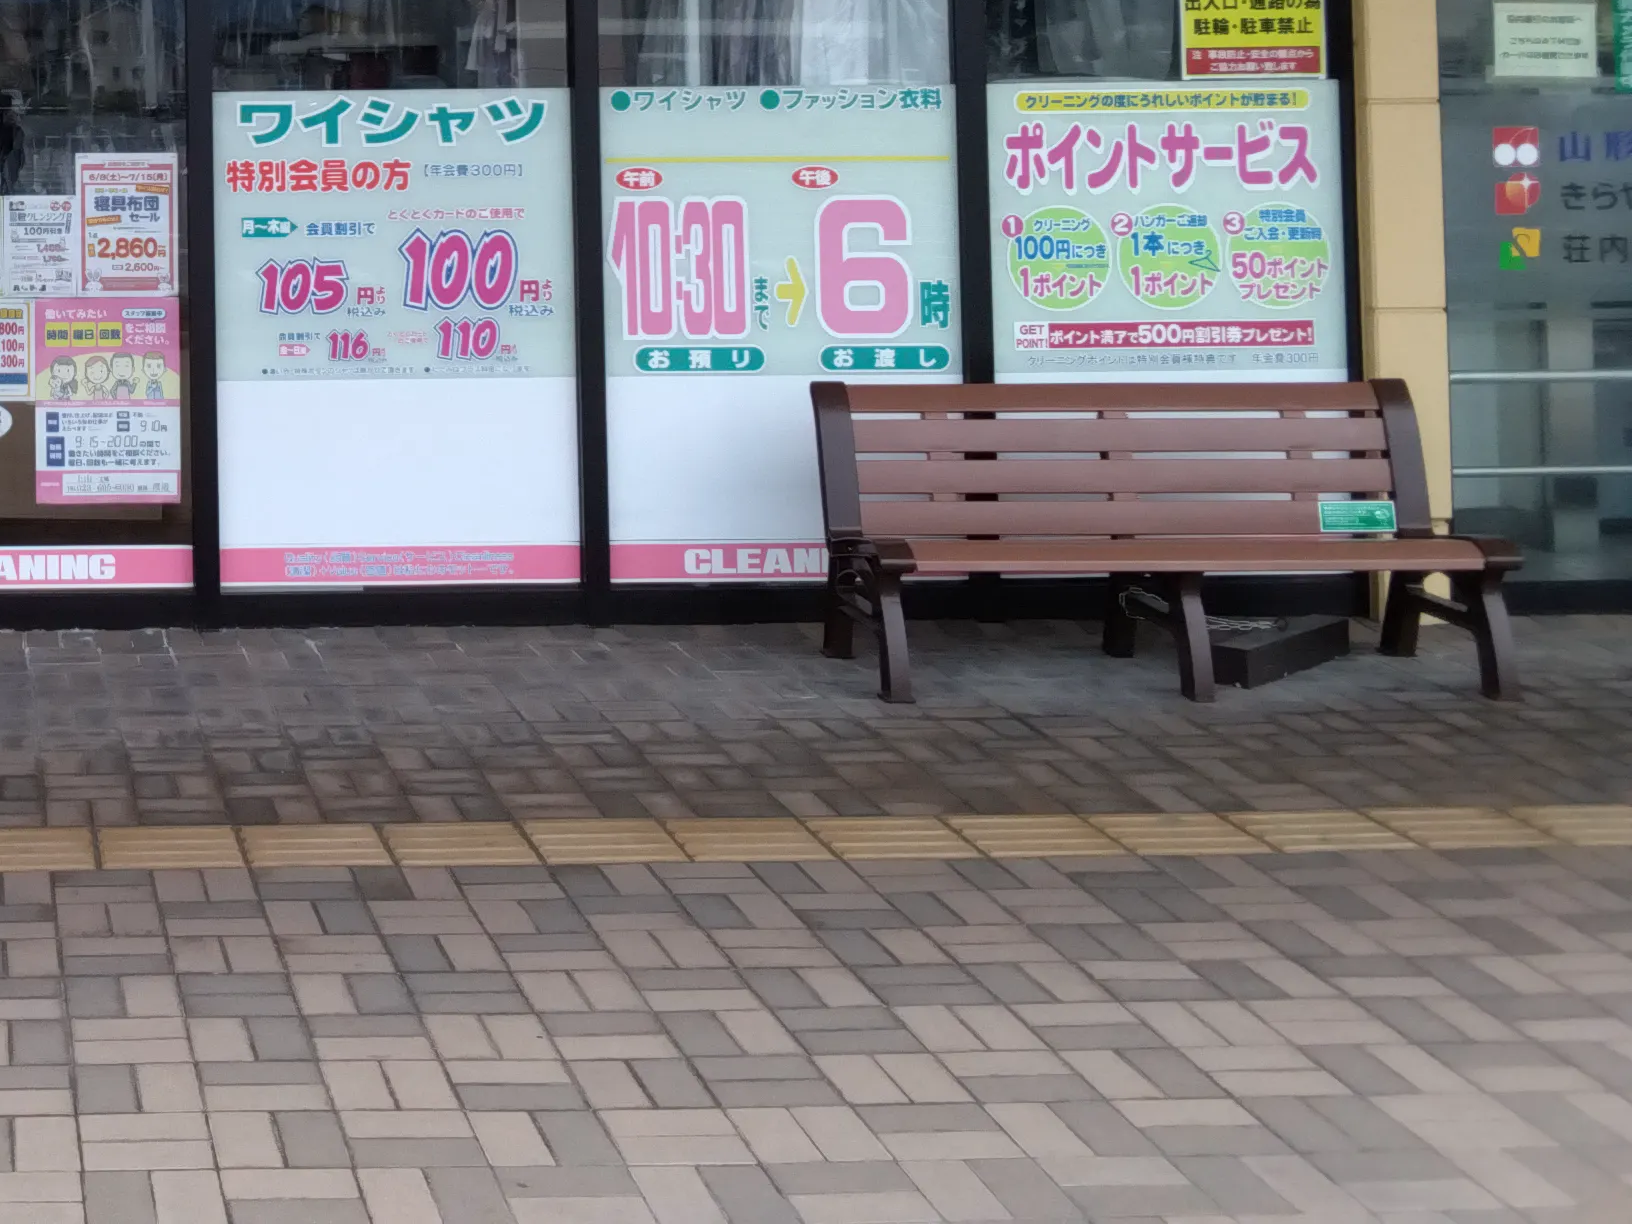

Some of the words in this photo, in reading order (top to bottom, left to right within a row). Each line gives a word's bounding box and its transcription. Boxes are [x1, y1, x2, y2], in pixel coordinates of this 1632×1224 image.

[1194, 17, 1313, 35] 駐輪・駐車禁止
[783, 88, 942, 110] ファッション衣料
[238, 97, 546, 146] ワイシャツ
[1005, 121, 1318, 191] ポイントサービス
[226, 158, 411, 192] 特別会員の方
[623, 171, 656, 187] 午前
[799, 170, 831, 186] 午後
[94, 196, 160, 212] 寝具布団
[129, 213, 161, 223] セール
[387, 208, 525, 220] とくとくカードのご使用で
[1259, 209, 1306, 223] 特別会員
[306, 222, 375, 236] 会員割引で
[1033, 218, 1091, 232] クリーニング
[1562, 233, 1629, 264] 荘内
[1019, 267, 1102, 298] 1ポイント
[1131, 266, 1214, 297] 1ポイント
[1239, 282, 1321, 300] プレゼント
[45, 309, 108, 320] 働いてみたい
[347, 307, 386, 318] 税込み
[509, 305, 554, 317] 税込み
[47, 329, 69, 341] 時間
[73, 329, 95, 341] 曜日
[99, 329, 122, 341] 回数
[125, 323, 167, 334] をご相談
[279, 333, 321, 341] 会員割引で
[1019, 325, 1045, 336] GET
[125, 336, 170, 345] ください。
[647, 349, 751, 369] お預り
[833, 348, 936, 367] お渡し
